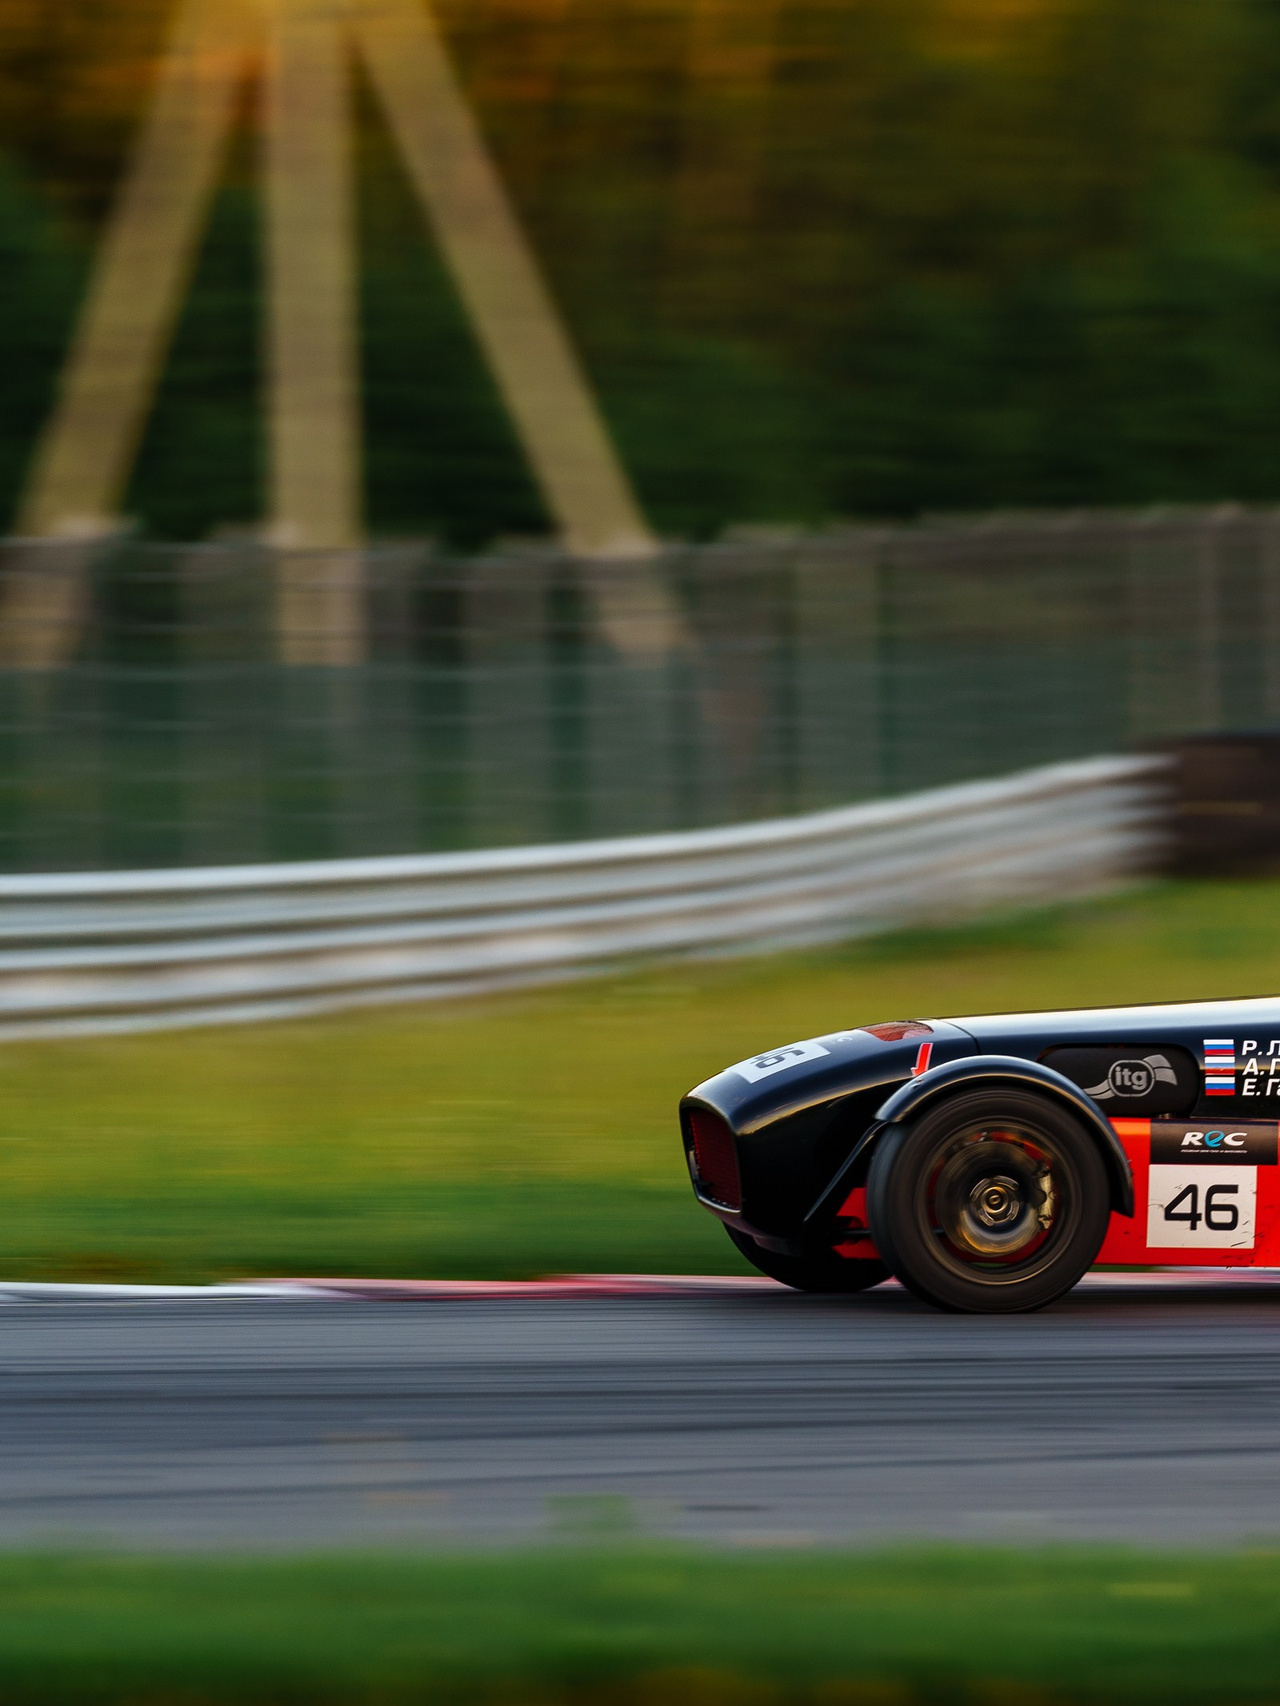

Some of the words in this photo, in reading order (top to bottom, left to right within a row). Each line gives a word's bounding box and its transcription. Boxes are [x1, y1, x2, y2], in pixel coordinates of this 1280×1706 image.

[1241, 1040, 1263, 1056] Р.
[1242, 1058, 1265, 1076] А.
[1115, 1066, 1148, 1091] itg
[1242, 1078, 1261, 1096] Е.
[1164, 1184, 1239, 1231] 46
